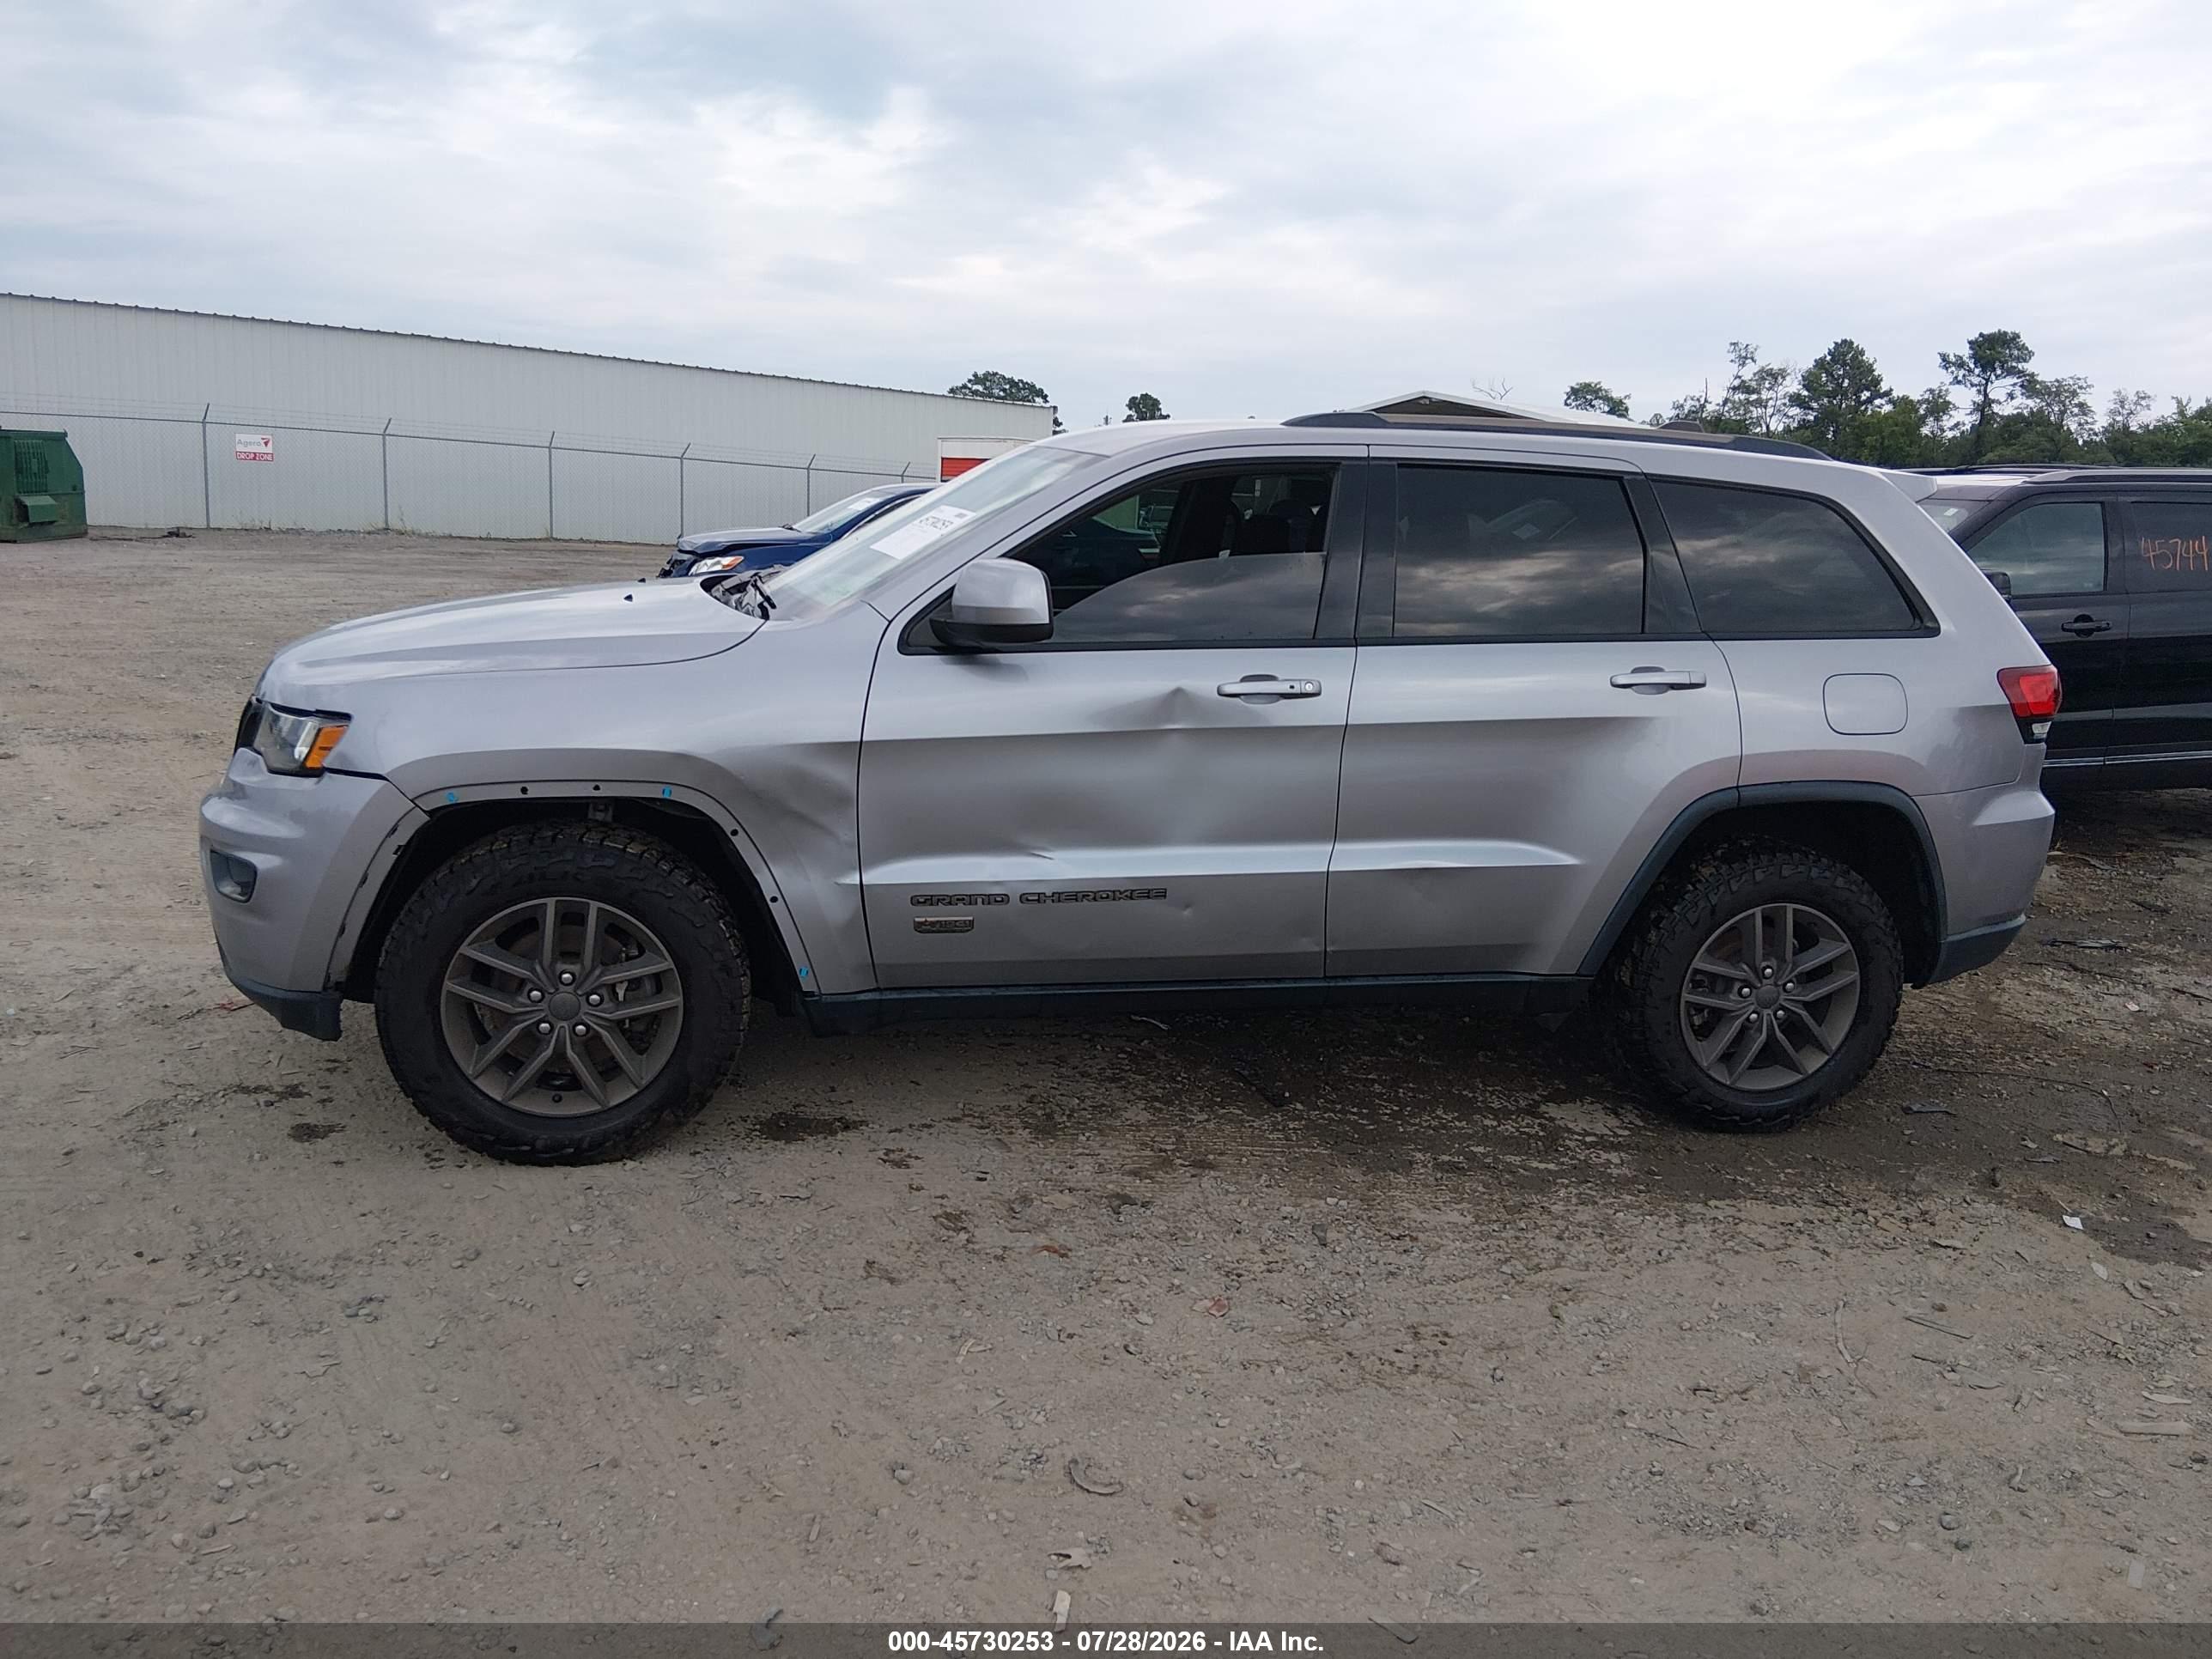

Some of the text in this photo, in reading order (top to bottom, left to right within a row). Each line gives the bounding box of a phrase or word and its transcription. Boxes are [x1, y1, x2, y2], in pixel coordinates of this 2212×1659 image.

[2142, 535, 2209, 571] 45744
[910, 888, 1168, 907] GRAND CHEROKEE
